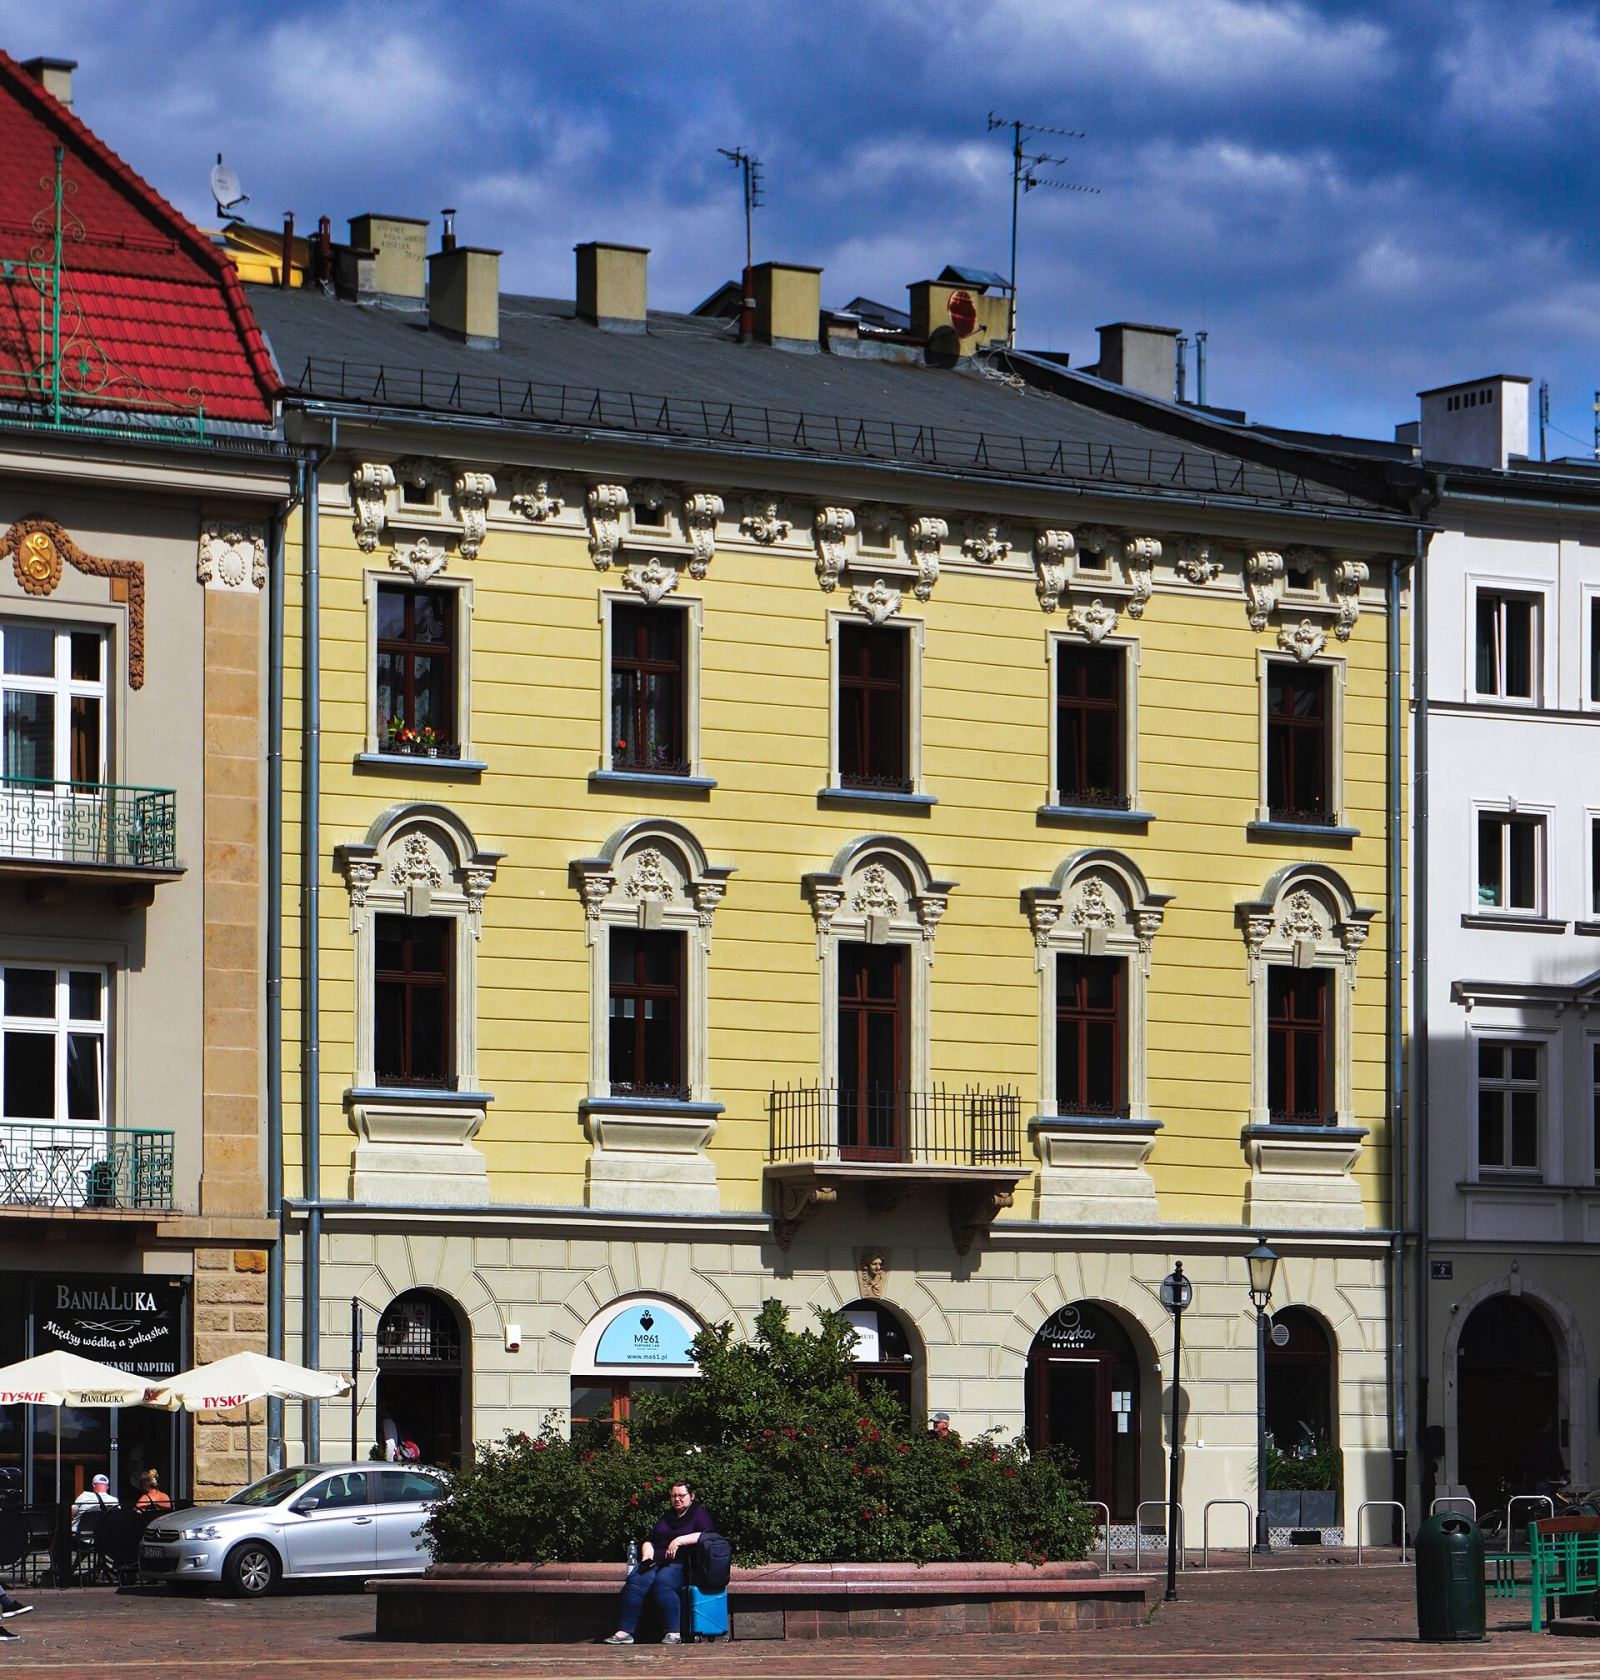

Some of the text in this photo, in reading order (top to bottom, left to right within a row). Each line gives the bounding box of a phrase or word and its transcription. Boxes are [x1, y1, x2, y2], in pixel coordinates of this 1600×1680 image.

[1440, 1266, 1446, 1275] 2
[43, 1320, 81, 1346] Między
[83, 1335, 117, 1350] wódką
[128, 1325, 169, 1348] zakąską
[137, 1362, 175, 1373] NAPITKI
[1, 1391, 47, 1403] TYSKIE
